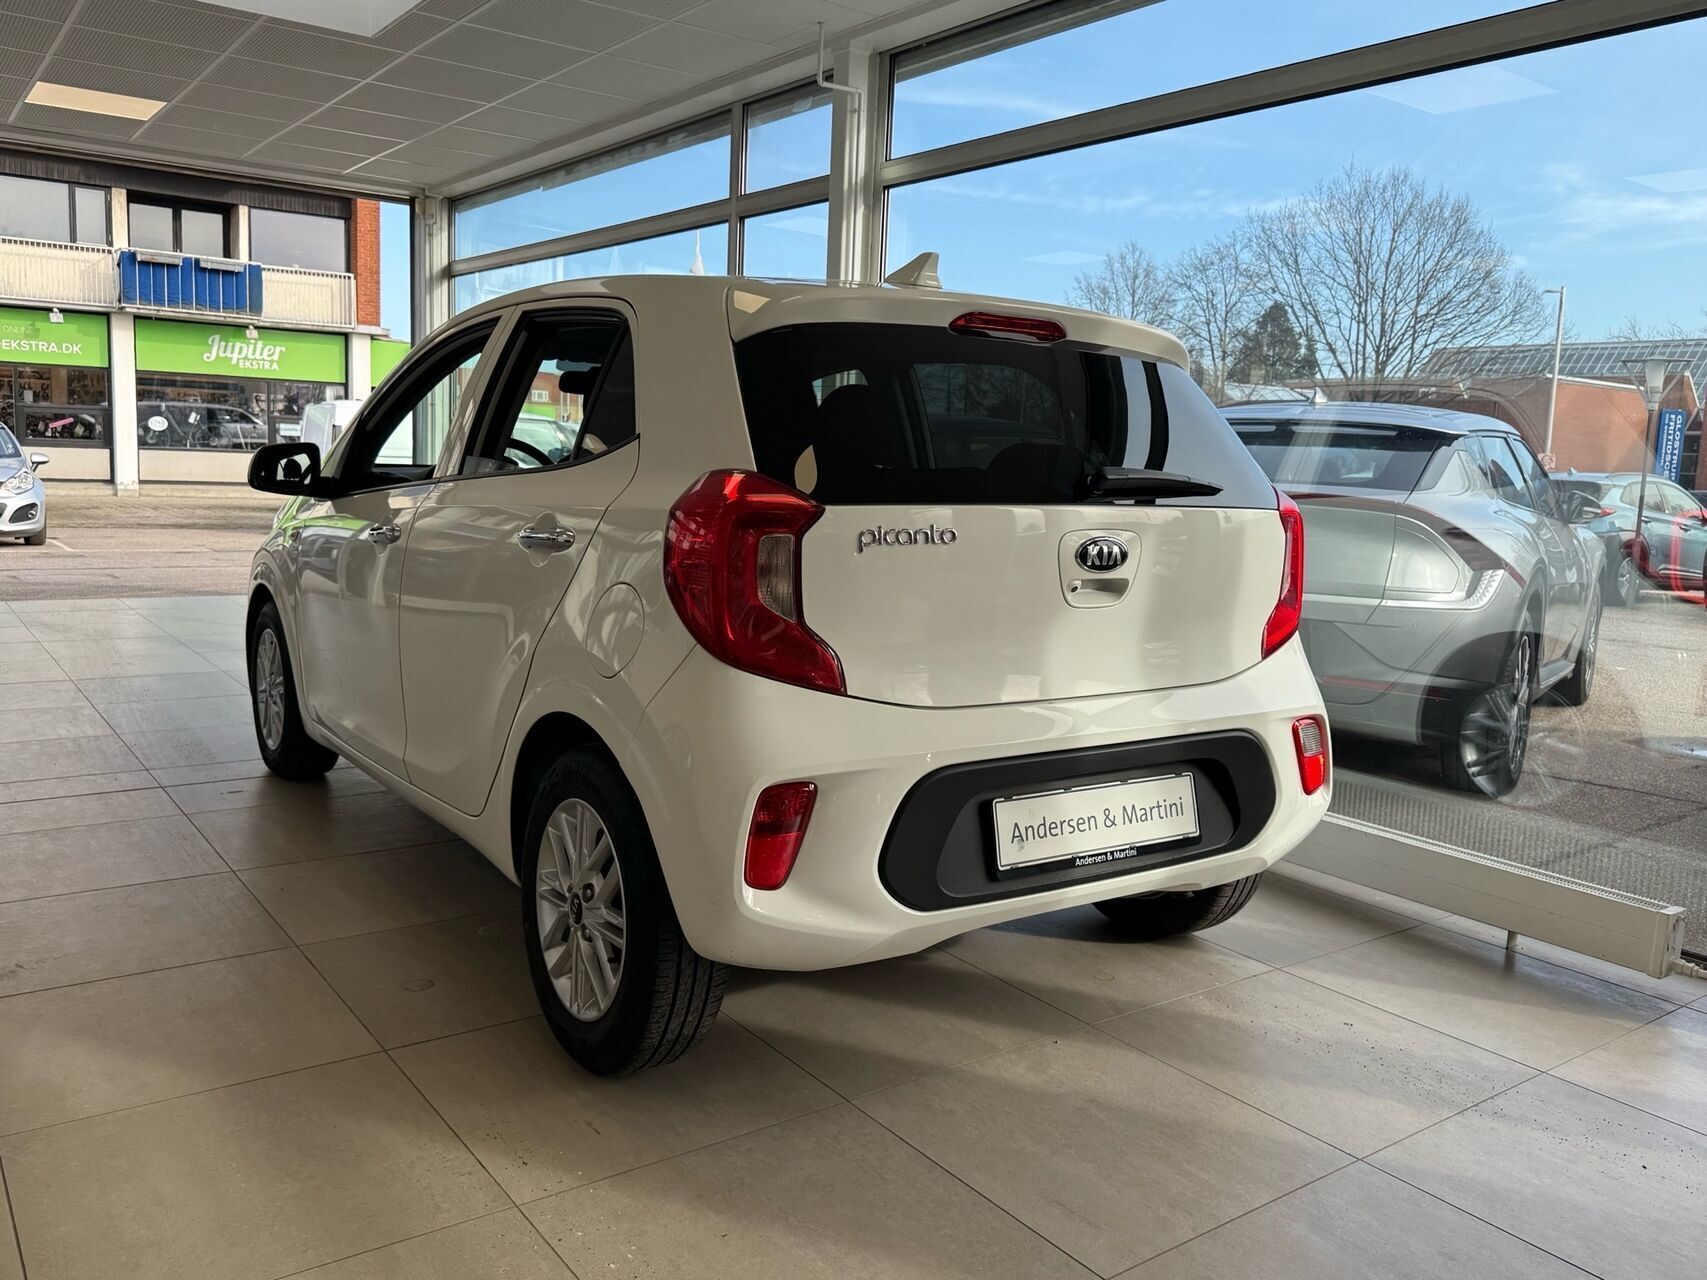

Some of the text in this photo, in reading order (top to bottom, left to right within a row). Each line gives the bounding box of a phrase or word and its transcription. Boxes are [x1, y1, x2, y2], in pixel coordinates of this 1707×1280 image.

[0, 339, 83, 355] EKSTRA.DK
[203, 334, 286, 365] Jupiter
[239, 359, 280, 371] EKSTRA
[1671, 415, 1682, 480] GLOSTRUP
[858, 523, 958, 554] picanto
[1086, 544, 1122, 566] KIA
[1011, 796, 1185, 844] Andersen & Martini
[1075, 847, 1137, 867] Andersen & Martini
